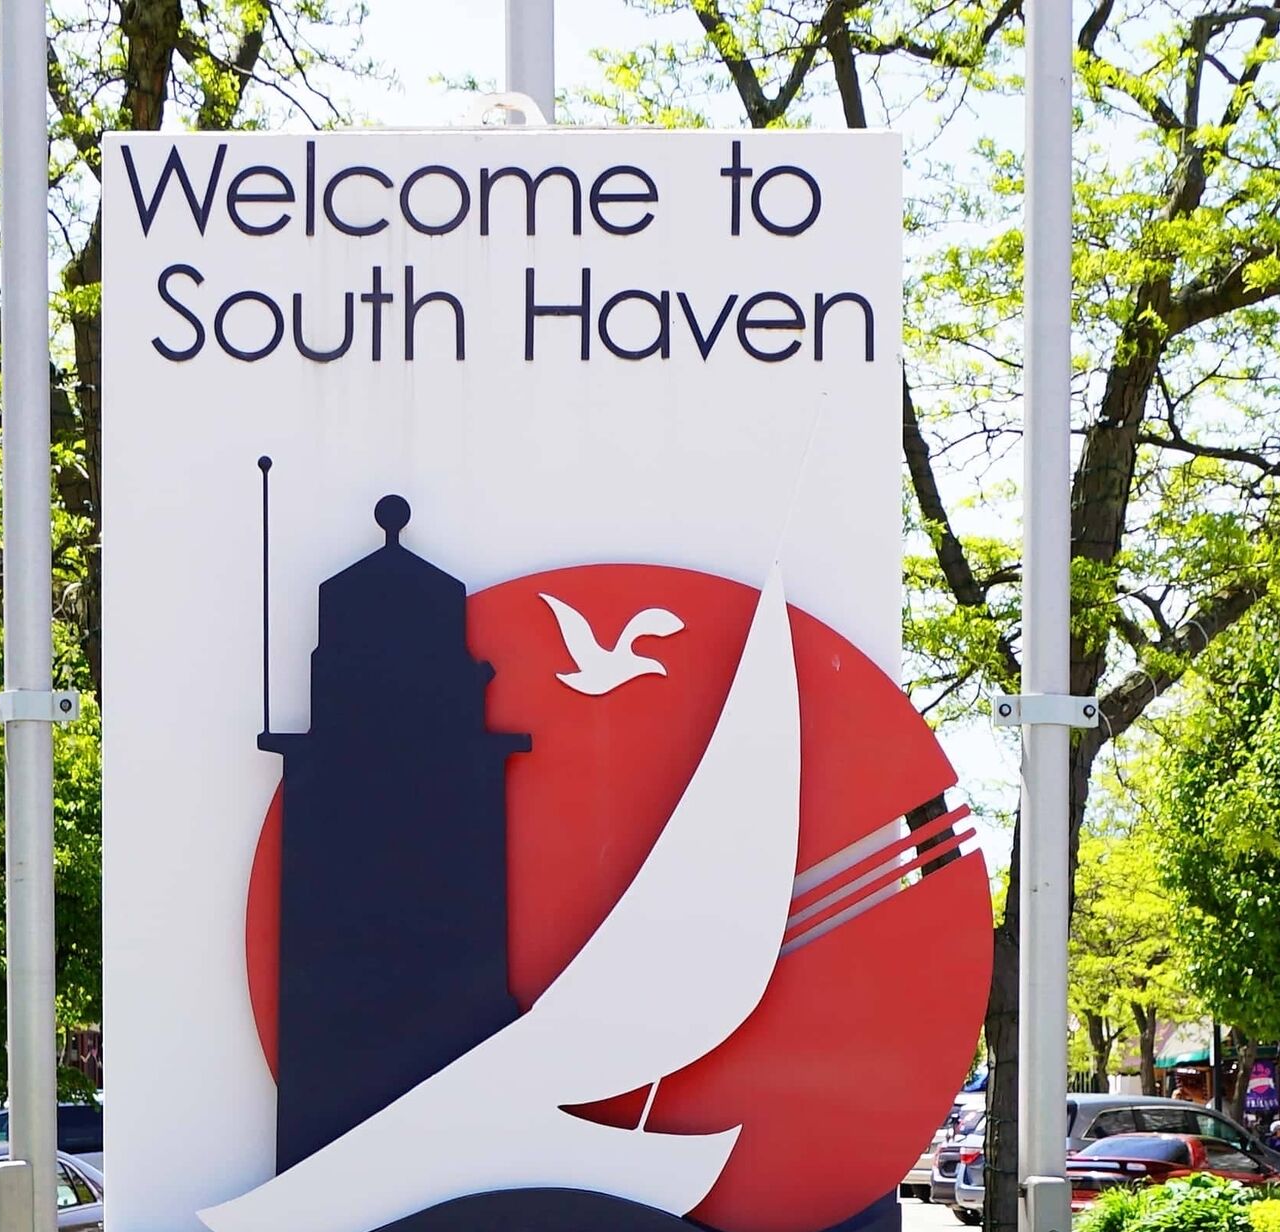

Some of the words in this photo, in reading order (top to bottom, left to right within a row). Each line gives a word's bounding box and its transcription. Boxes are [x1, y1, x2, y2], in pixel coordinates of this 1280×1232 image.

[120, 140, 658, 238] Welcome
[720, 140, 822, 237] to
[151, 263, 465, 364] South
[525, 266, 876, 363] Haven
